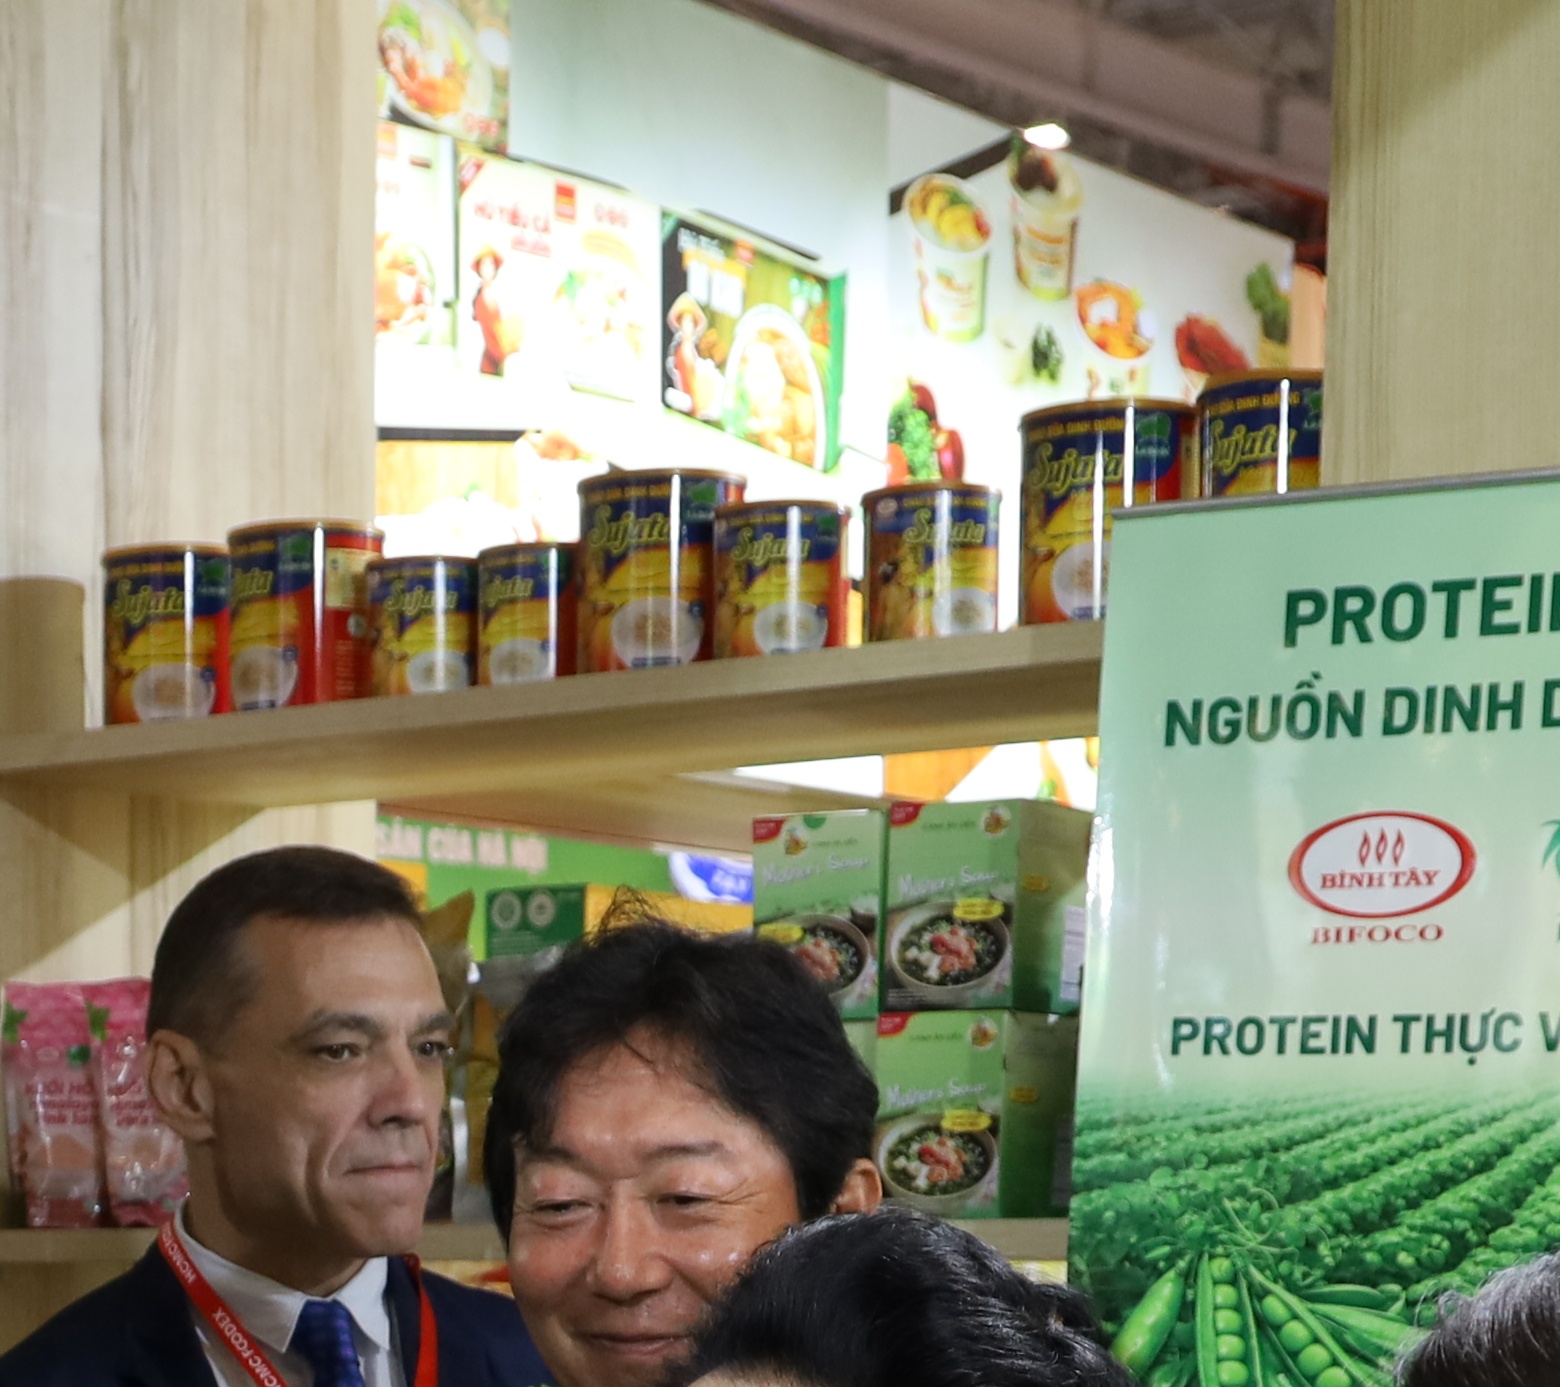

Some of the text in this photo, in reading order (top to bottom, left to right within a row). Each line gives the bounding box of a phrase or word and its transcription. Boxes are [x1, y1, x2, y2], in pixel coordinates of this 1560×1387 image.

[1162, 670, 1367, 749] NGUỒN
[1379, 680, 1525, 737] DINH
[1319, 866, 1441, 890] BÌNH TÂY
[1310, 923, 1445, 945] BIFOCO
[1169, 1012, 1379, 1057] PROTEIN
[1391, 1007, 1525, 1066] THỰC
